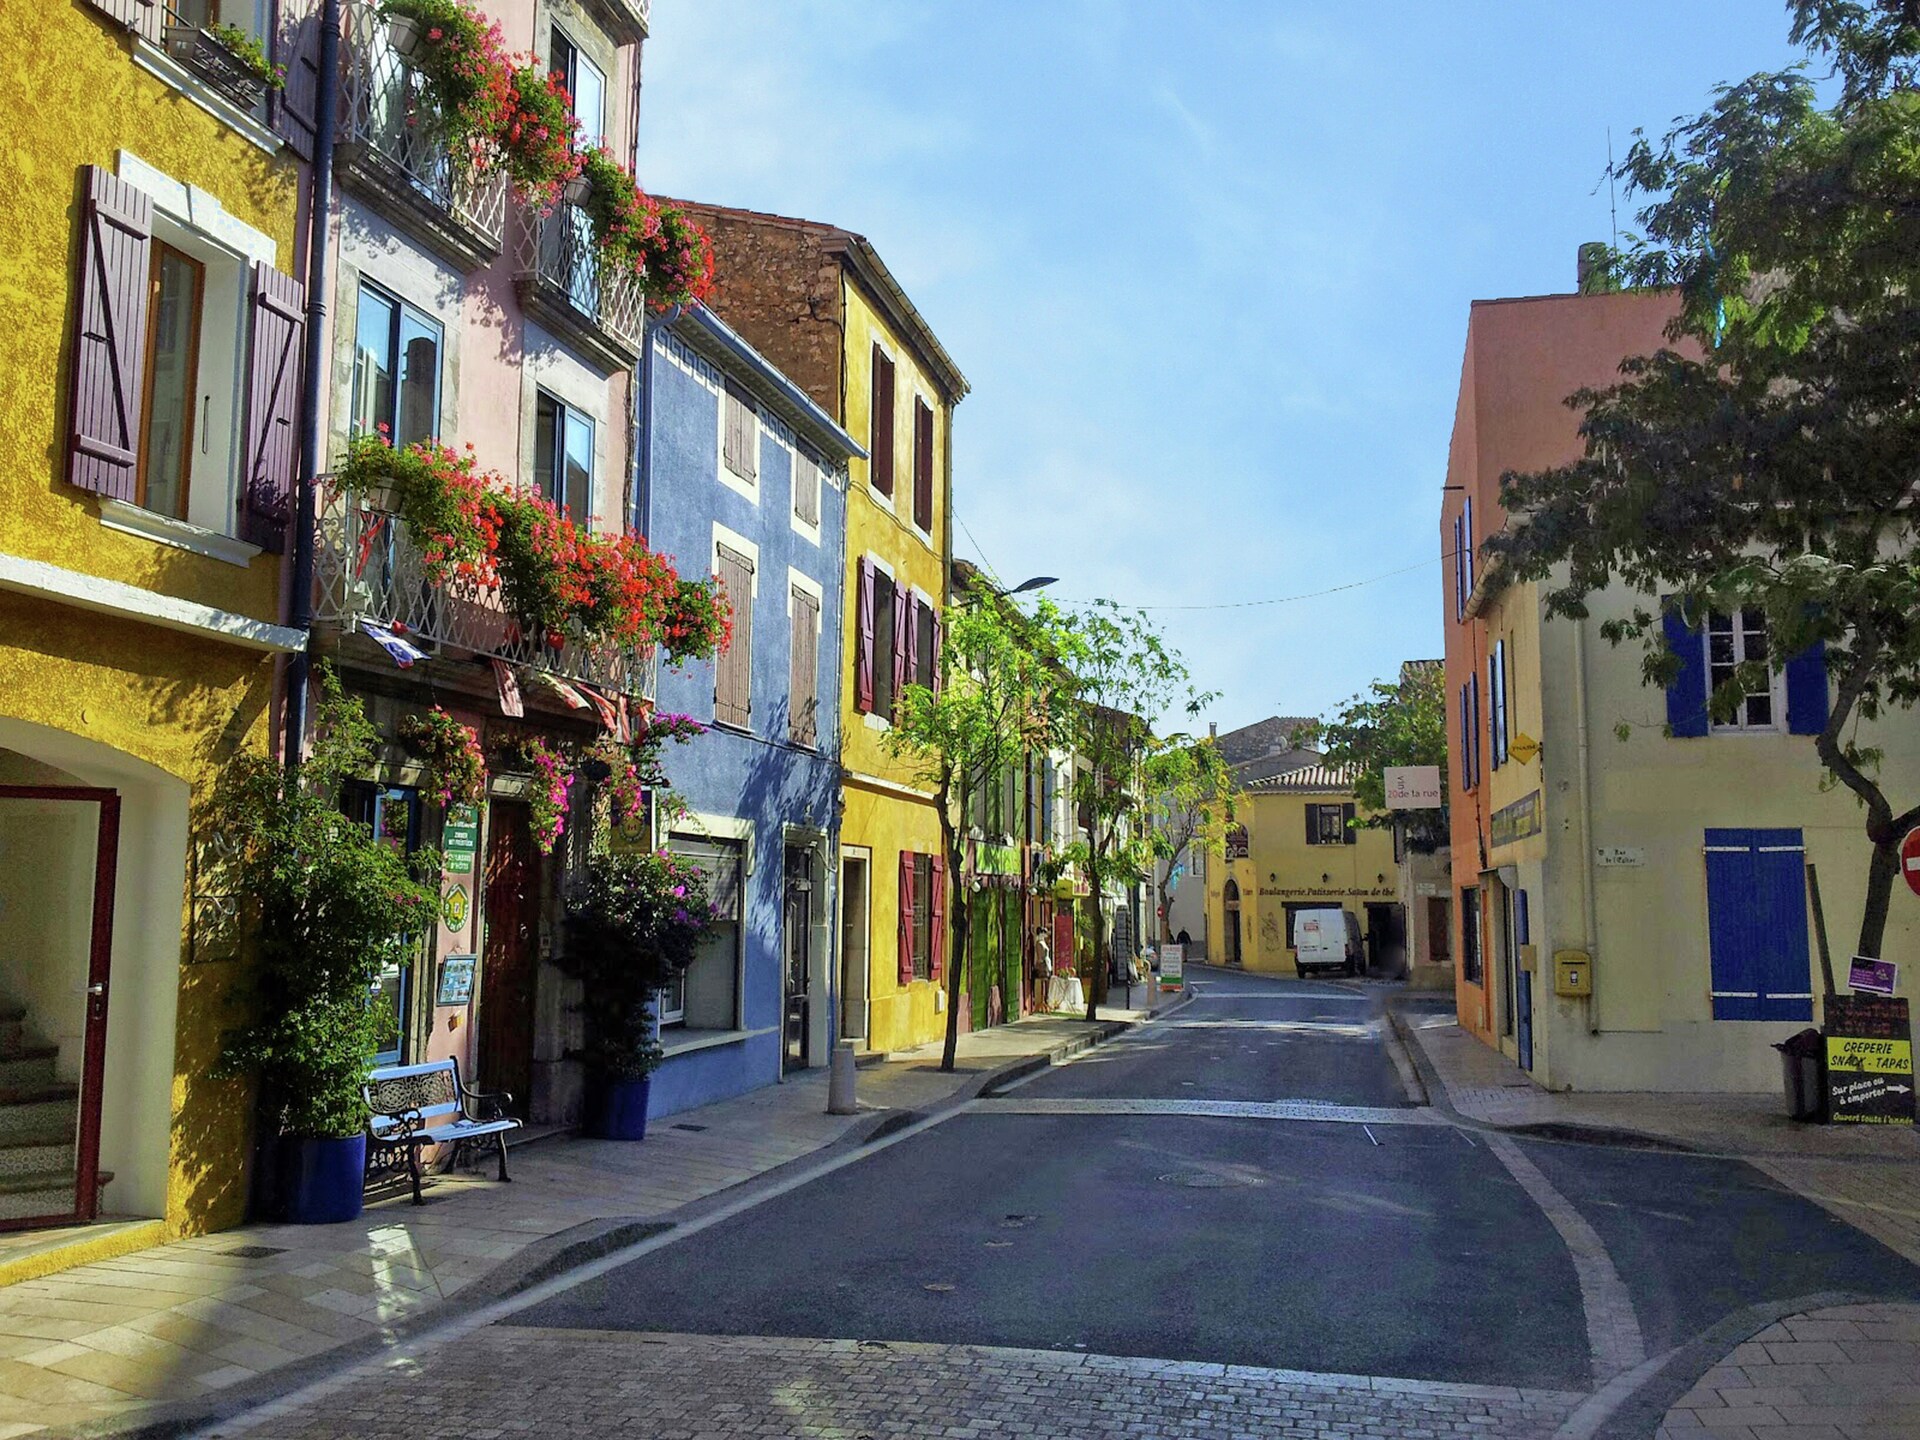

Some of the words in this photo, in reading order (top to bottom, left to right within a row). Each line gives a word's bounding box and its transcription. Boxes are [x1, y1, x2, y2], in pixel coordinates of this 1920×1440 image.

[1422, 790, 1439, 798] rue
[1370, 887, 1381, 896] de
[1843, 1042, 1894, 1055] CREPERIE
[1831, 1055, 1867, 1068] SNACK
[1876, 1057, 1910, 1070] TAPAS
[1831, 1085, 1848, 1096] Sur
[1848, 1080, 1873, 1094] place
[1872, 1077, 1885, 1085] ou
[1847, 1088, 1887, 1104] emporter
[1832, 1112, 1860, 1122] Ouvert
[1860, 1114, 1882, 1123] toute
